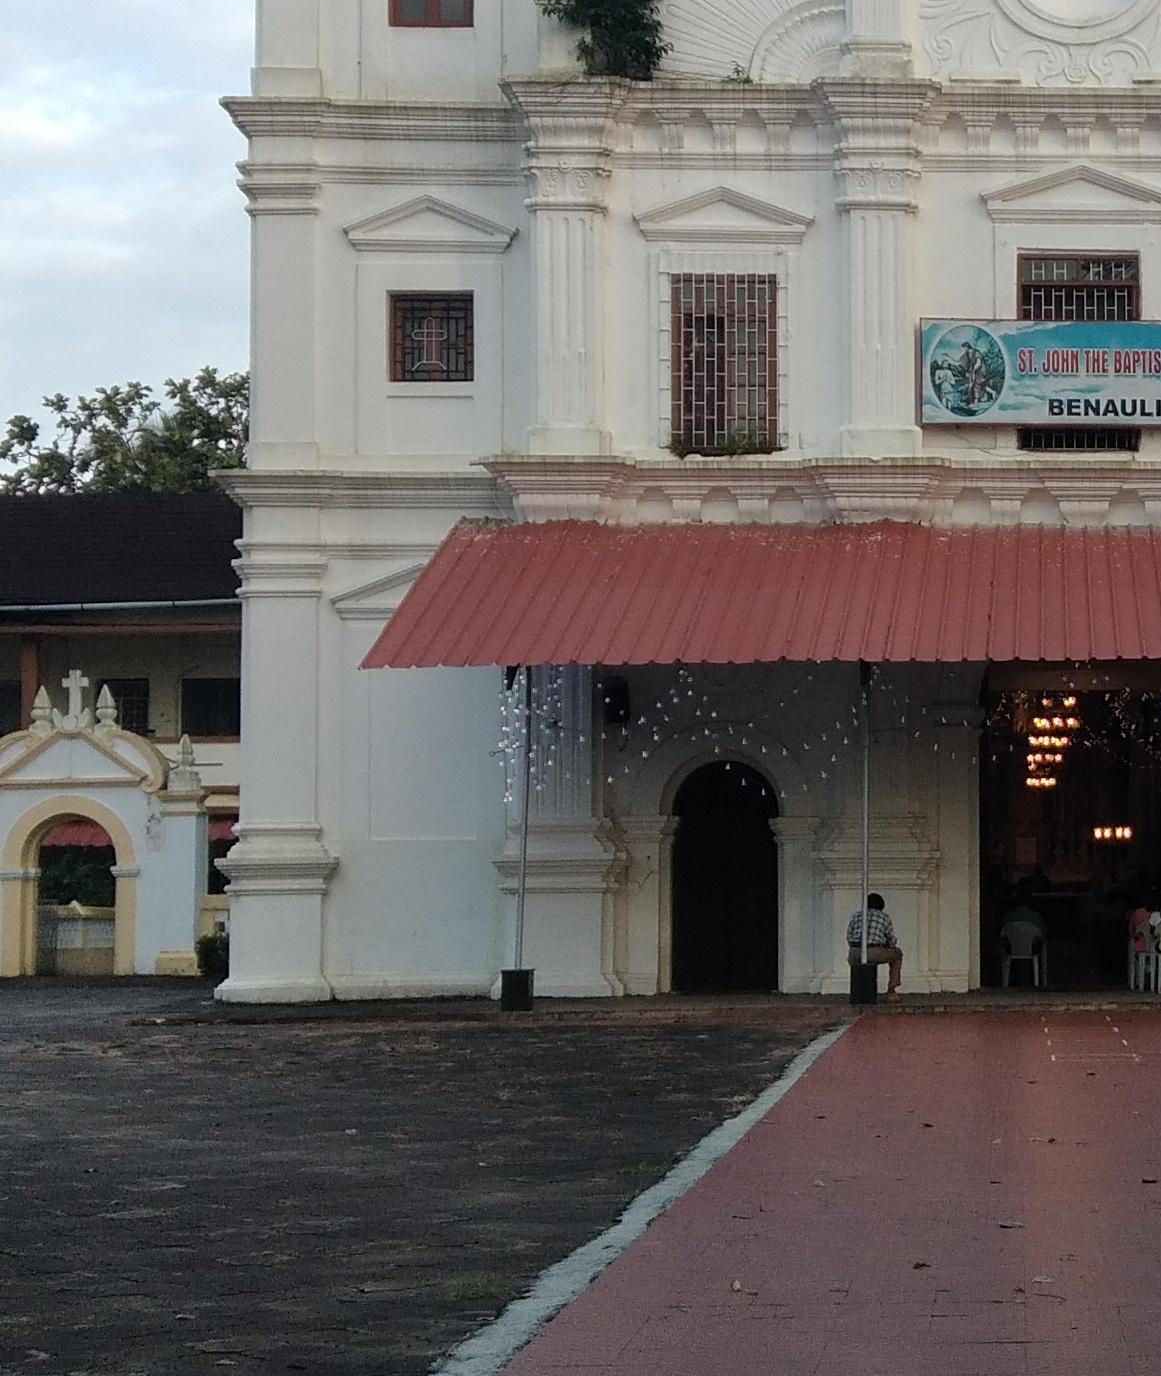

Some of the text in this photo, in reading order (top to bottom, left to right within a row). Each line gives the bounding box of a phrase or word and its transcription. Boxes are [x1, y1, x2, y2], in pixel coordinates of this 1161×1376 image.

[1018, 349, 1037, 373] ST.
[1042, 349, 1079, 374] JOHN
[1084, 349, 1109, 374] THE
